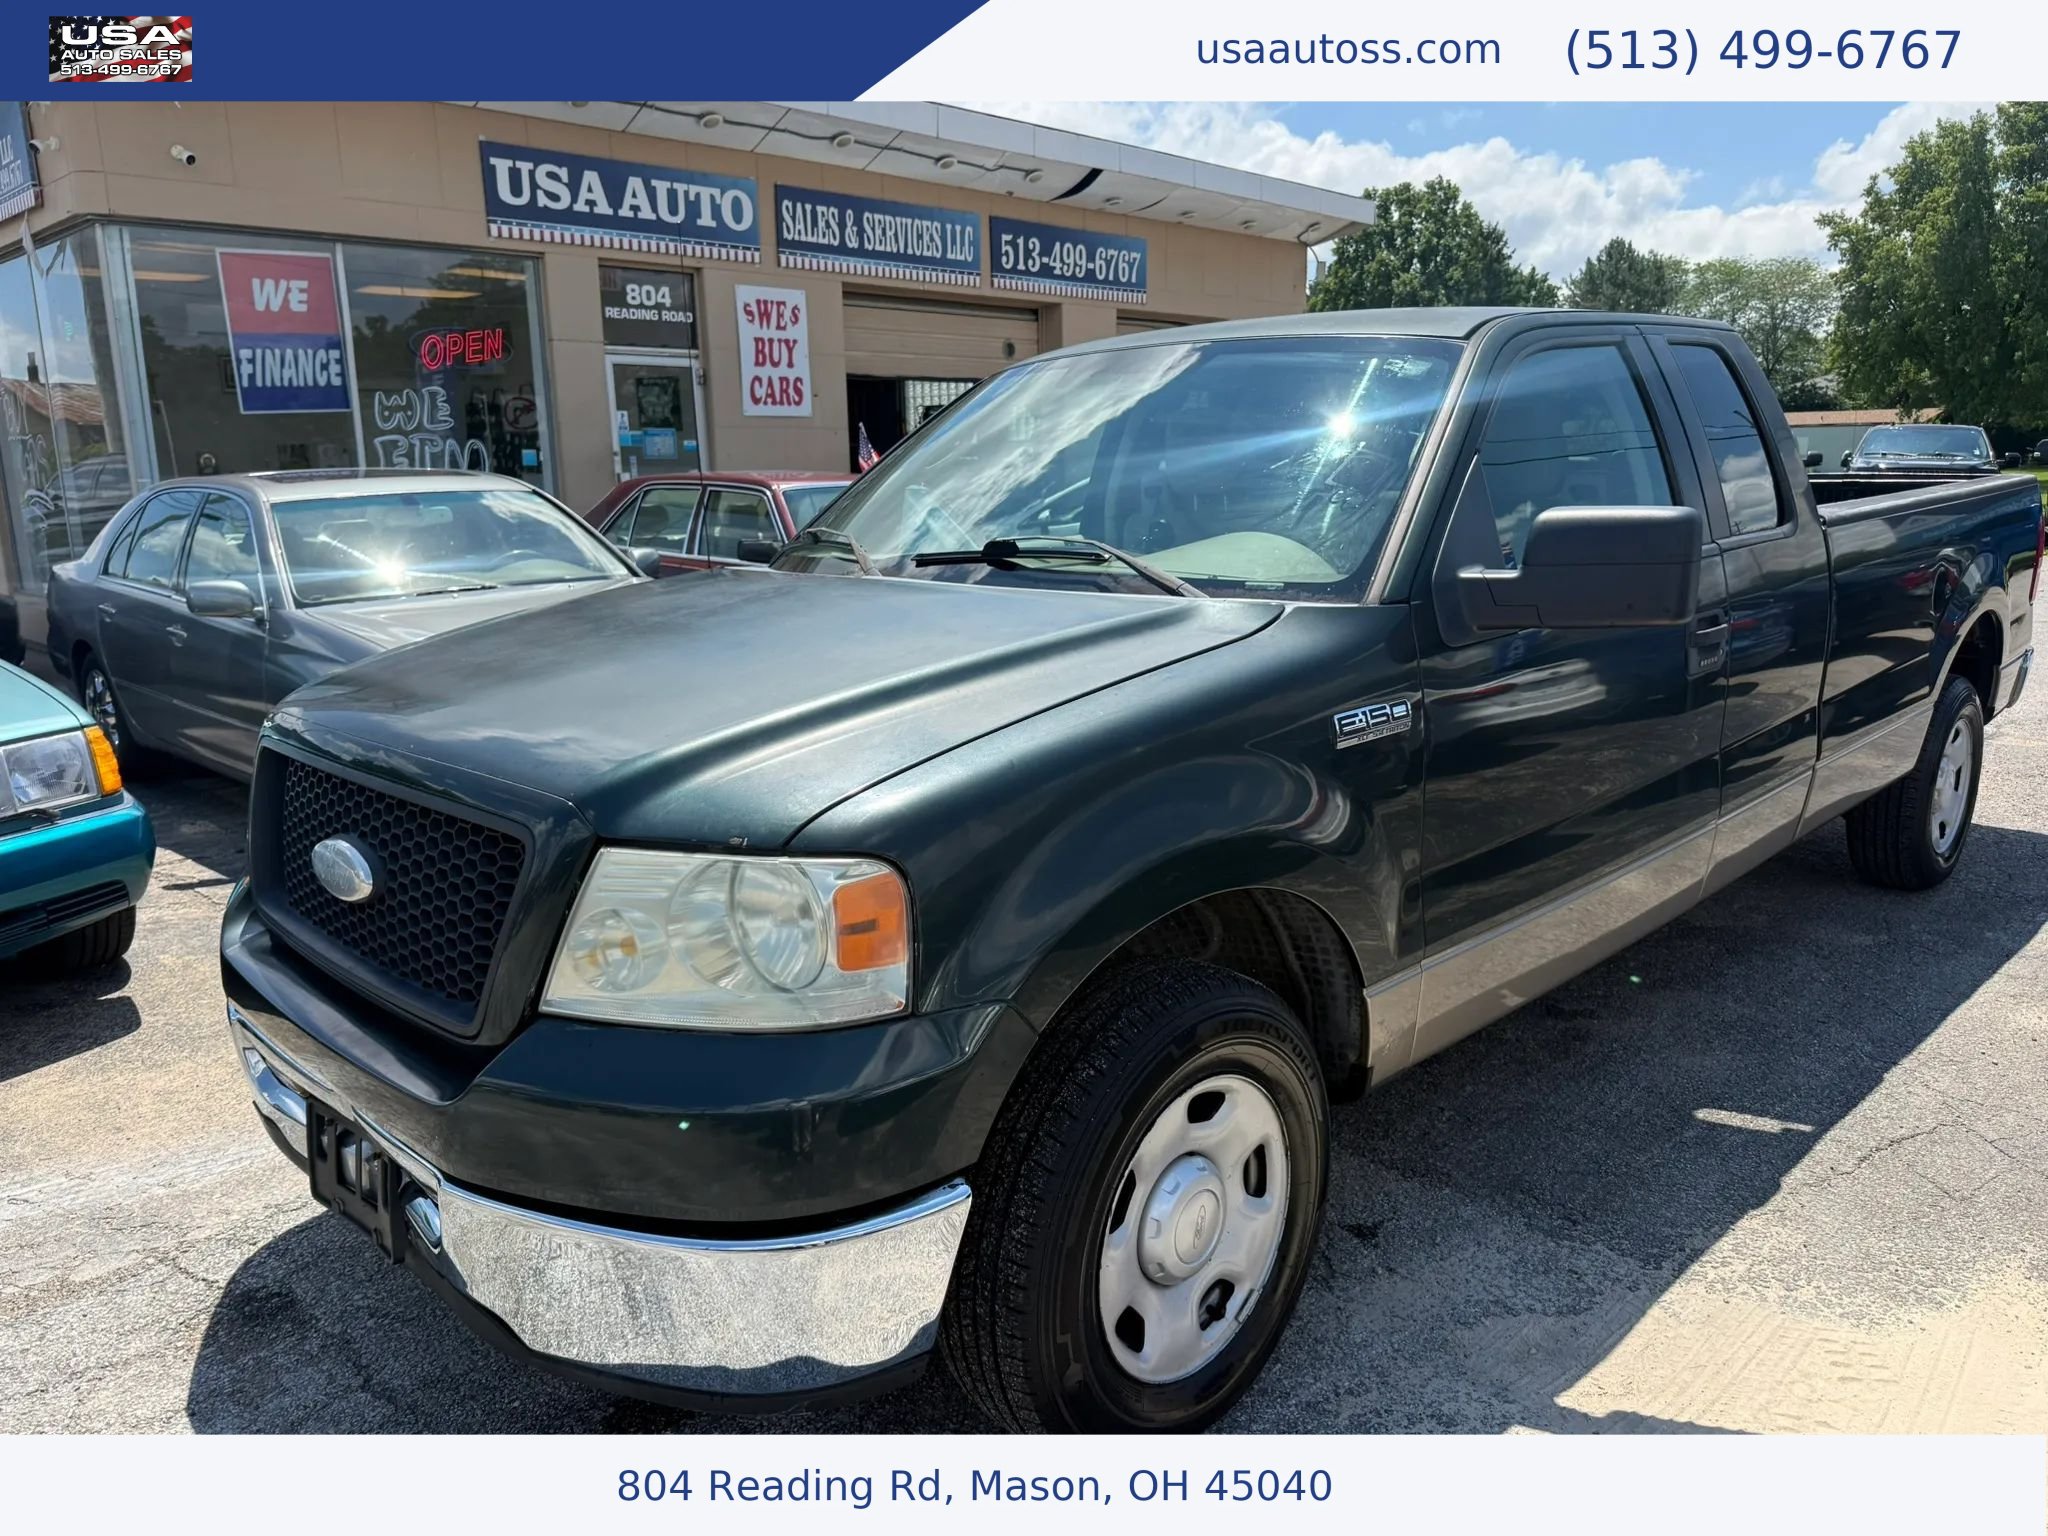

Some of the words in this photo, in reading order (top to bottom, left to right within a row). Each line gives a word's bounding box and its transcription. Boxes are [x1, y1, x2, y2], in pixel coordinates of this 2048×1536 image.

[489, 156, 614, 216] USA
[618, 175, 754, 232] AUTO
[782, 199, 840, 247] SALES
[845, 209, 859, 249] &
[863, 211, 942, 259] SERVICES
[946, 223, 974, 262] LLC
[1001, 233, 1141, 283] 513-499-6767
[251, 277, 309, 312] WE
[604, 306, 660, 321] READING
[661, 310, 694, 323] ROAD
[626, 283, 672, 308] 804
[239, 347, 342, 388] FINANCE
[420, 328, 504, 372] OPEN
[753, 336, 798, 369] BUY
[374, 385, 455, 431] WE
[750, 375, 804, 407] CARS
